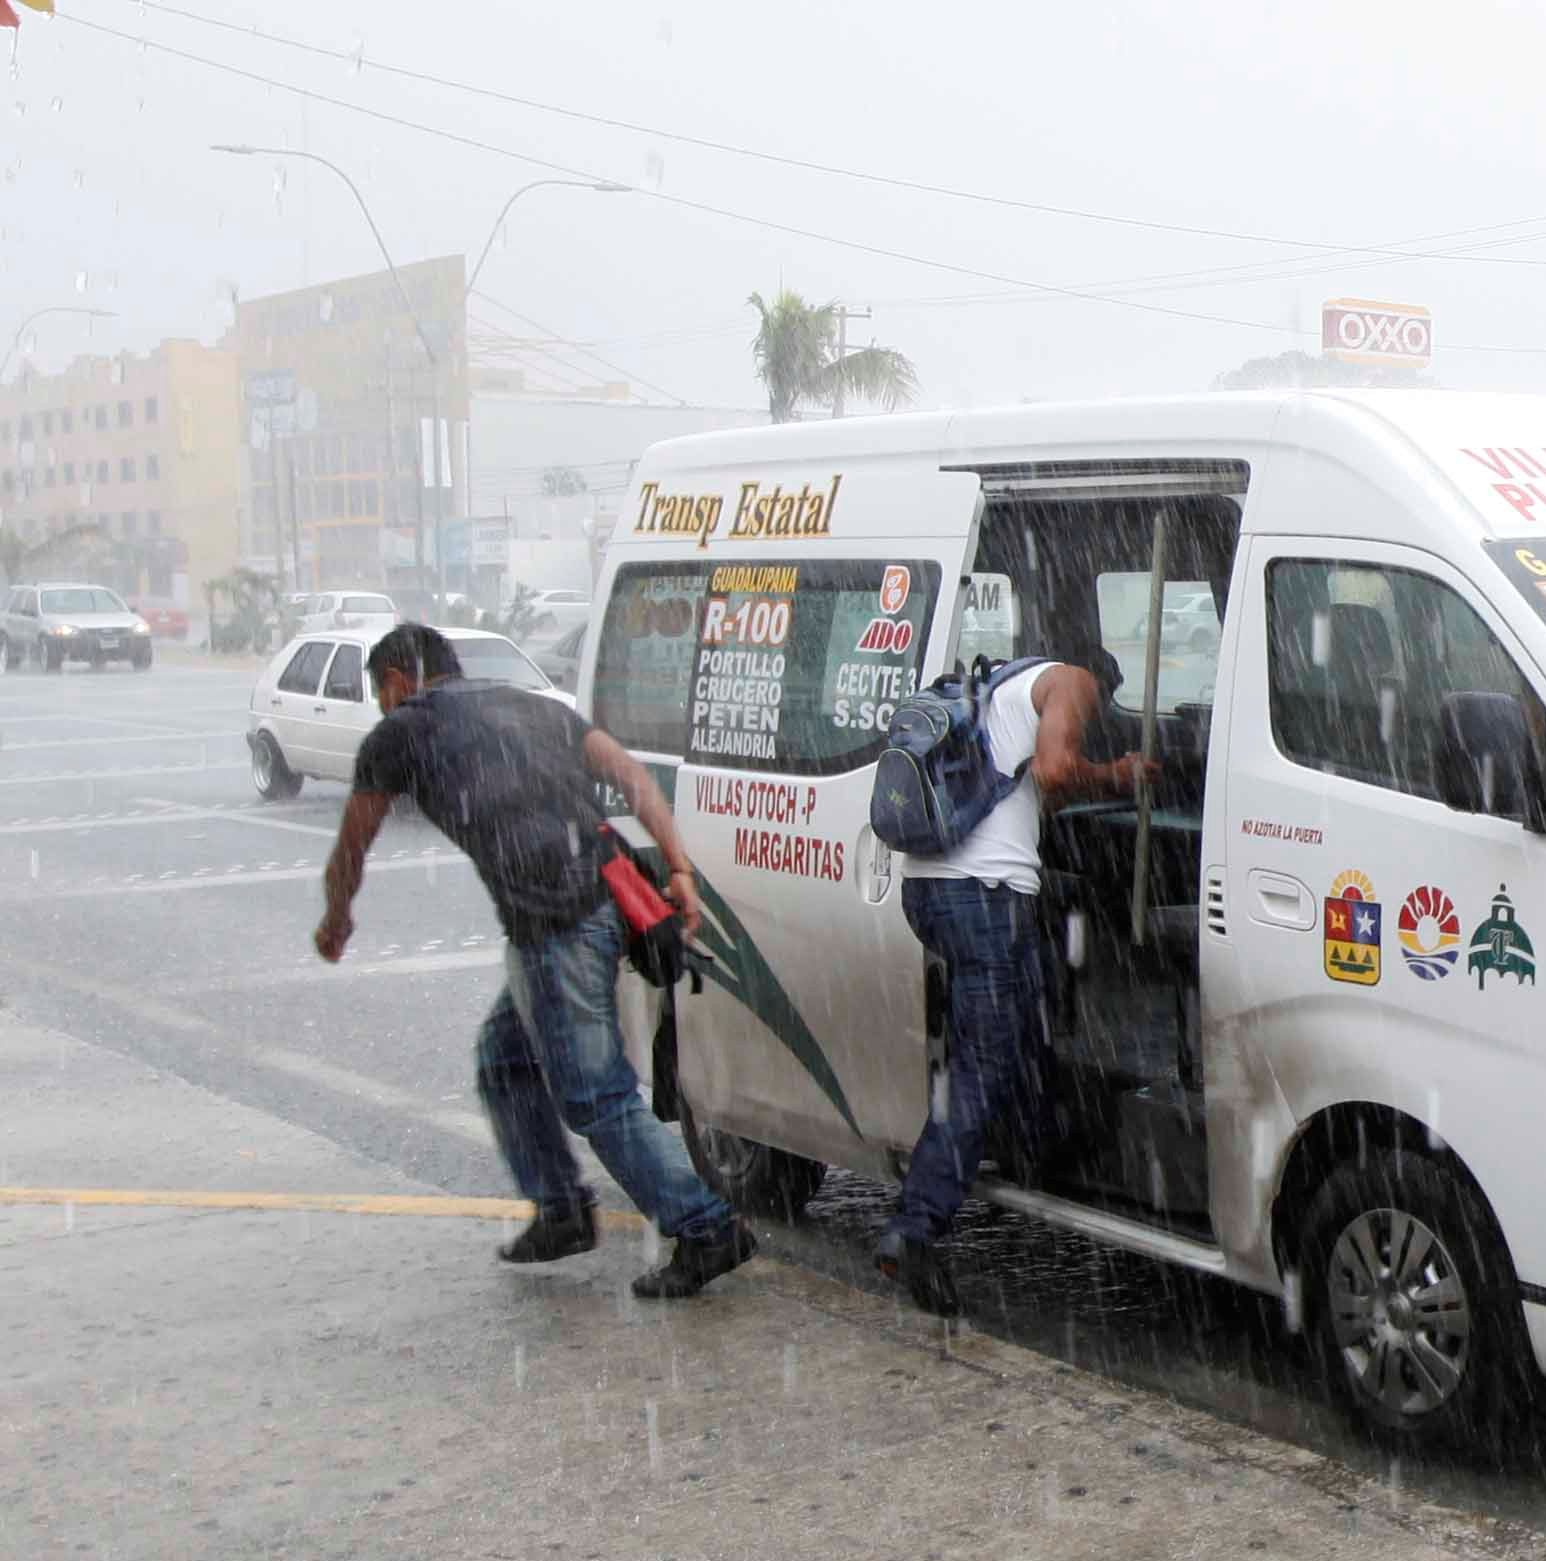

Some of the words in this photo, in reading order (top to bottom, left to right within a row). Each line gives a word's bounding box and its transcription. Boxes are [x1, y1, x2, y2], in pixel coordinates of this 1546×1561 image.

[1338, 313, 1428, 353] OXXO
[634, 481, 724, 550] Transp
[729, 473, 843, 539] Estatal
[712, 567, 798, 592] GUADALUPANA
[703, 599, 789, 645] R-100
[855, 618, 912, 655] ADO
[700, 650, 786, 679] PORTILLO
[837, 662, 903, 700] CECYTE
[904, 667, 918, 698] 3
[695, 676, 782, 706] CRUCERO
[692, 701, 780, 732] PETEN
[833, 698, 895, 733] S.SO
[690, 727, 777, 760] ALEJANDRIA
[696, 775, 743, 817] VILLAS
[747, 781, 798, 825] OTOCH
[1242, 819, 1253, 835] NO
[1253, 821, 1281, 838] AZOTAR
[1283, 825, 1293, 840] LA
[1295, 826, 1322, 845] PUERTA
[735, 827, 844, 882] MARGARITAS
